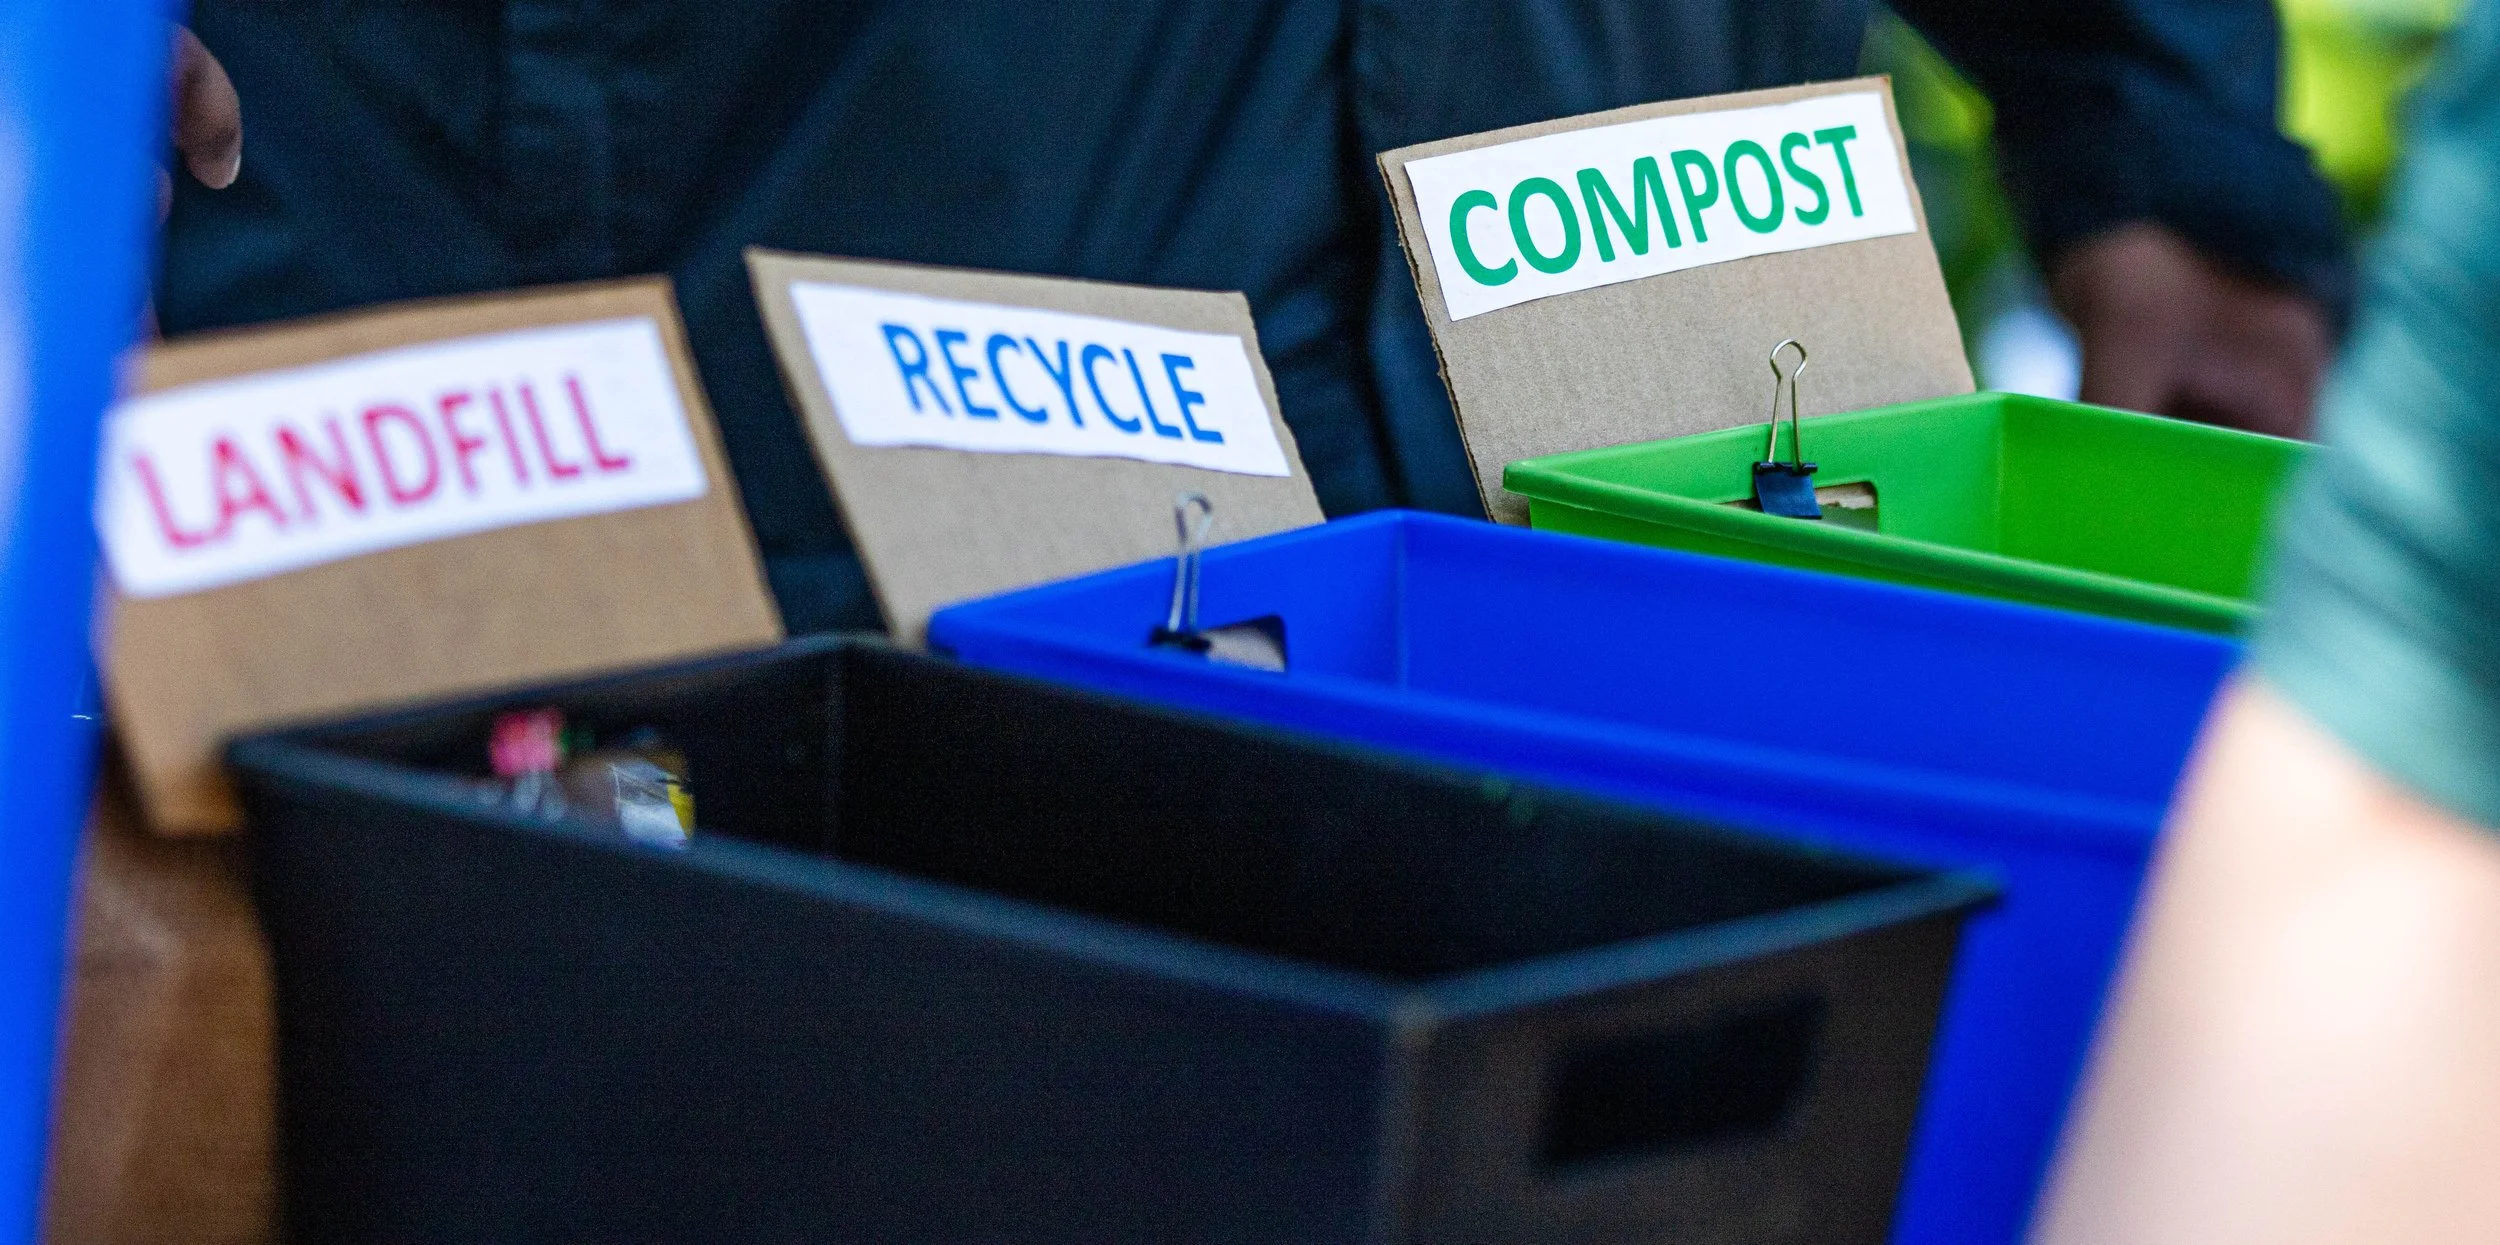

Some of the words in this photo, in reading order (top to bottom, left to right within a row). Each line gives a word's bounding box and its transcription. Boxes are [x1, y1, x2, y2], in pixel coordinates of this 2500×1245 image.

[1449, 125, 1863, 287] COMPOST
[132, 374, 632, 549] LANDFILL
[880, 322, 1225, 444] RECYCLE
